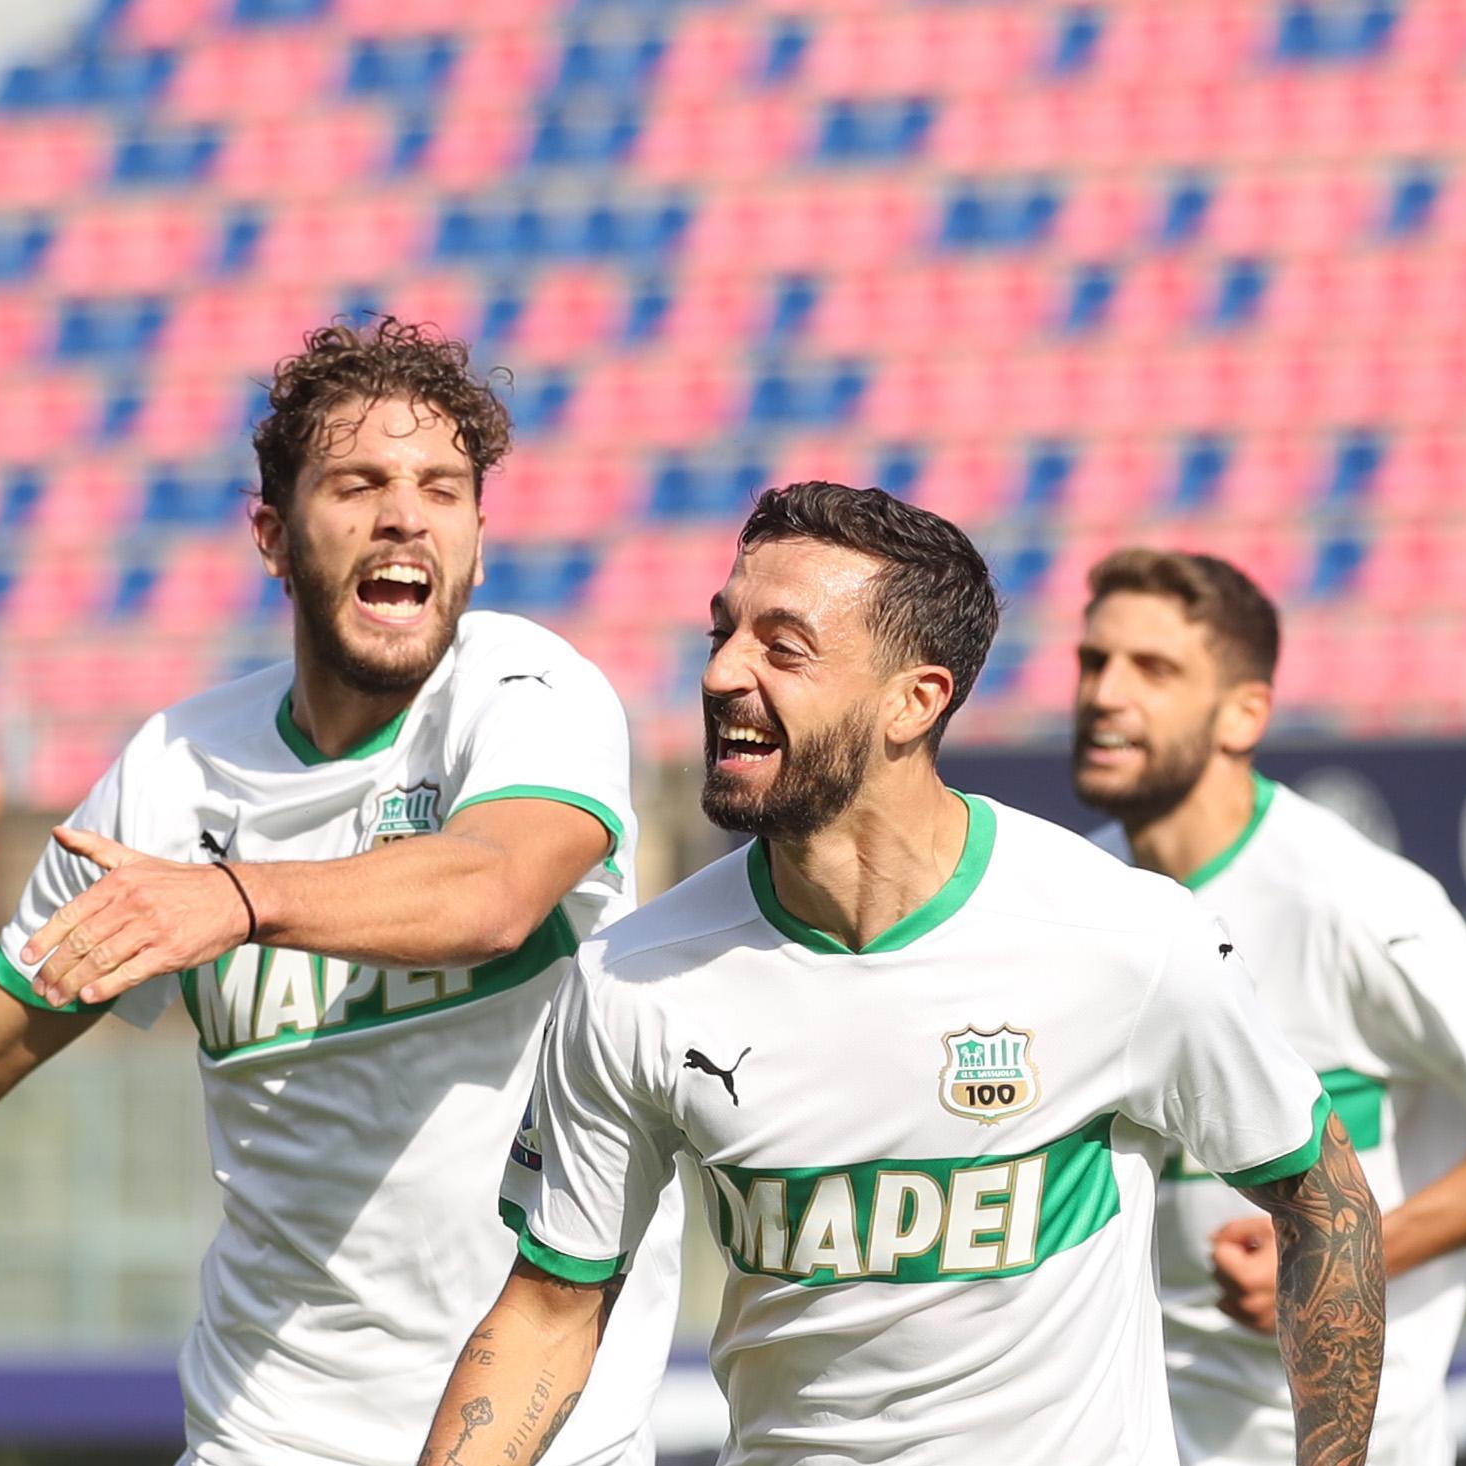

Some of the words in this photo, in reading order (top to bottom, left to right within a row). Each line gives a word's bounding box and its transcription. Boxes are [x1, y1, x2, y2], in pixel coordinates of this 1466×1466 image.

[195, 942, 472, 1050] MAP
[965, 1084, 1016, 1106] 100
[732, 1152, 1048, 1277] MAPEI
